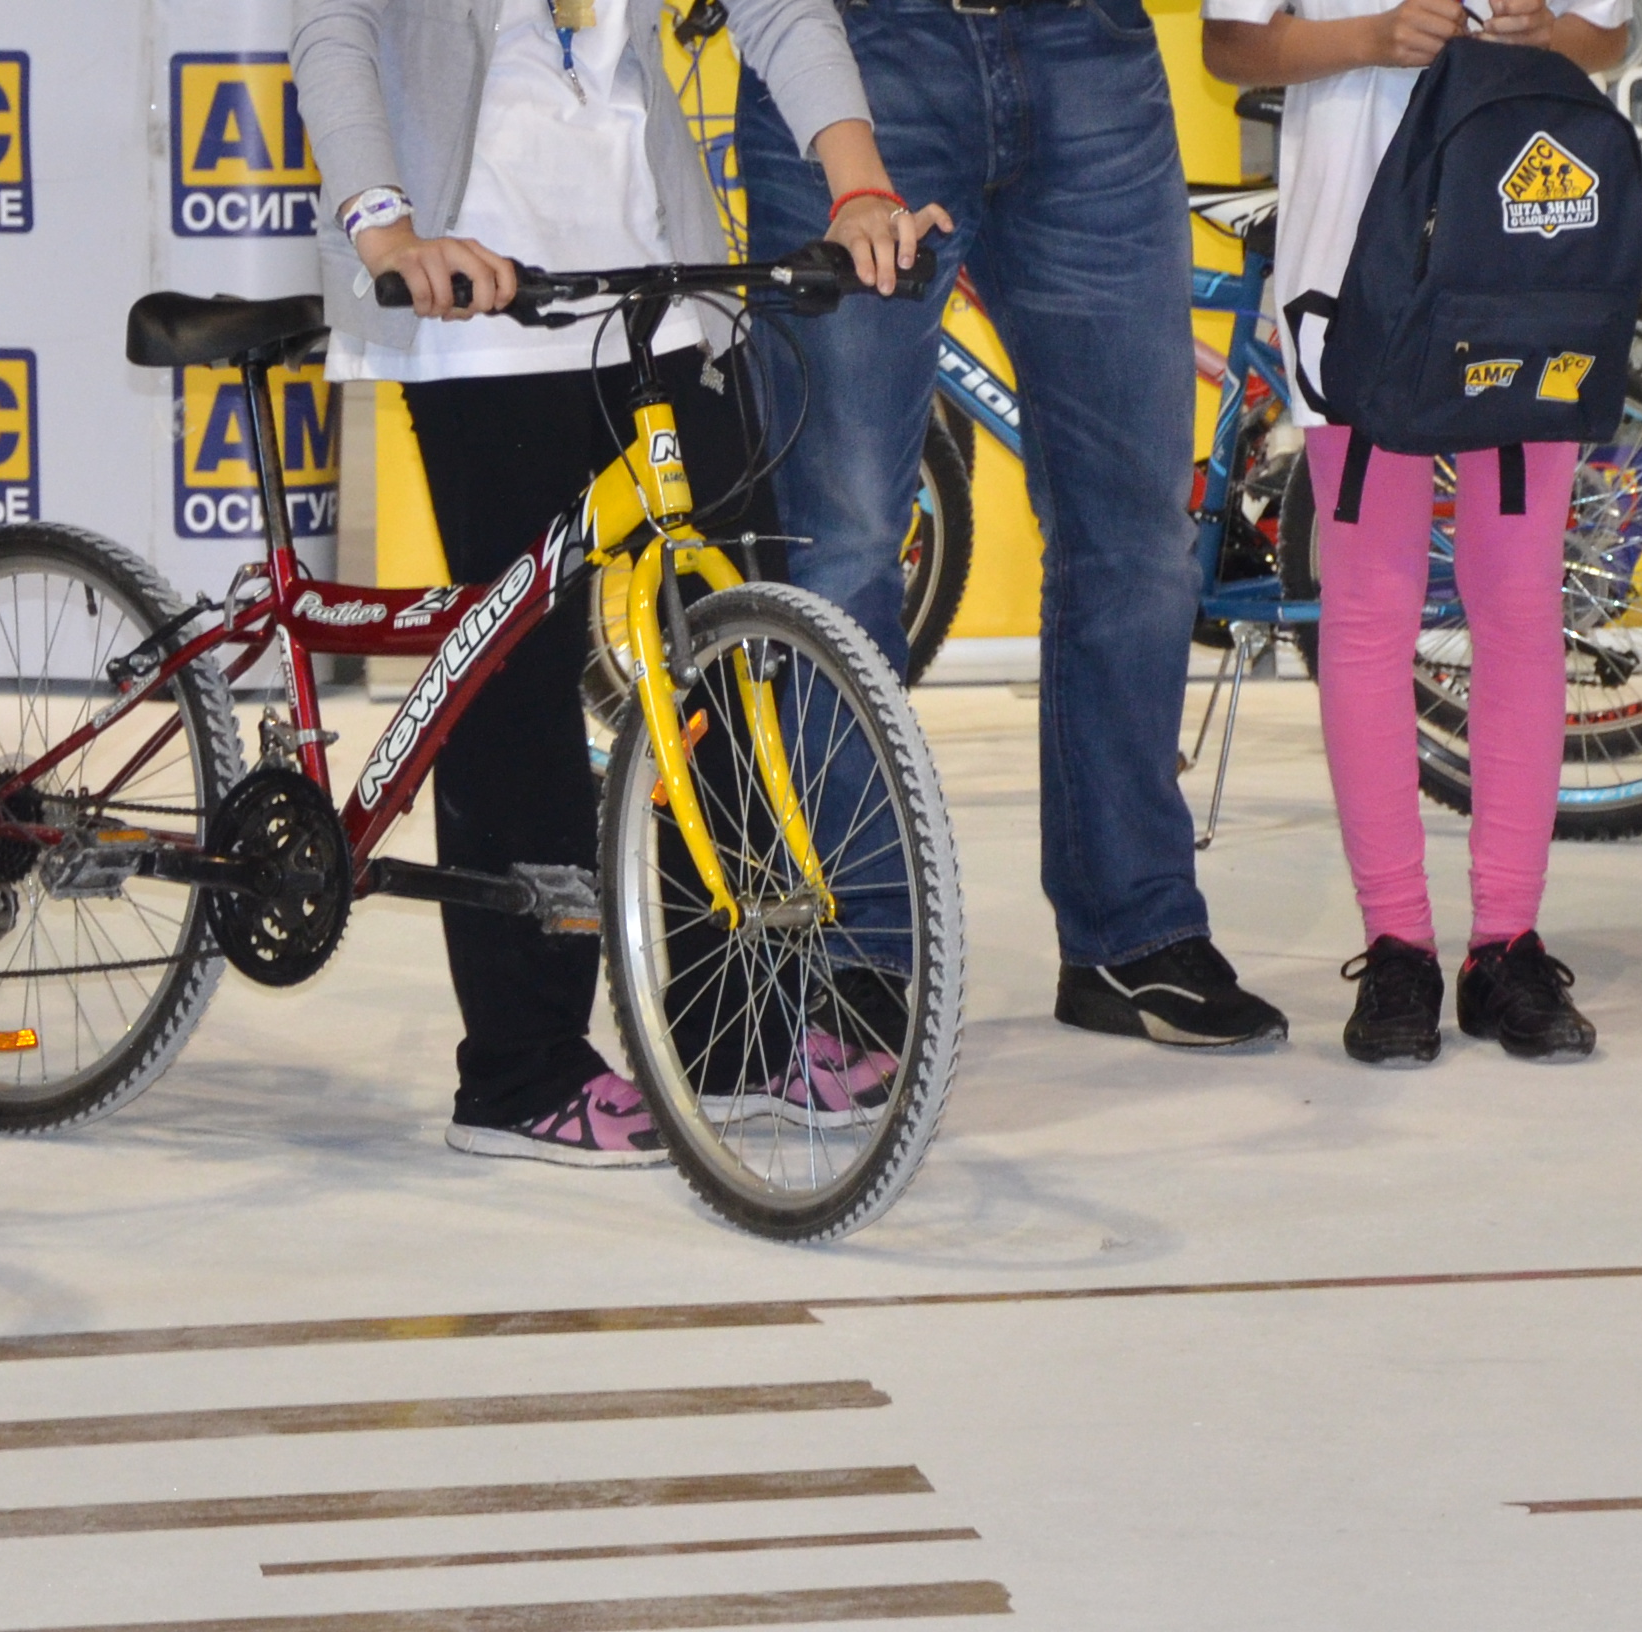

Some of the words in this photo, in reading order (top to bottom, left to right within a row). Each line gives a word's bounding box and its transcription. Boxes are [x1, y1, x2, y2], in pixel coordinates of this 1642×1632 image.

[1510, 144, 1554, 198] АМСС
[1509, 202, 1542, 217] ШТА
[1547, 199, 1592, 215] ЗНАШ
[193, 382, 343, 472] АМ
[293, 590, 387, 625] Panther
